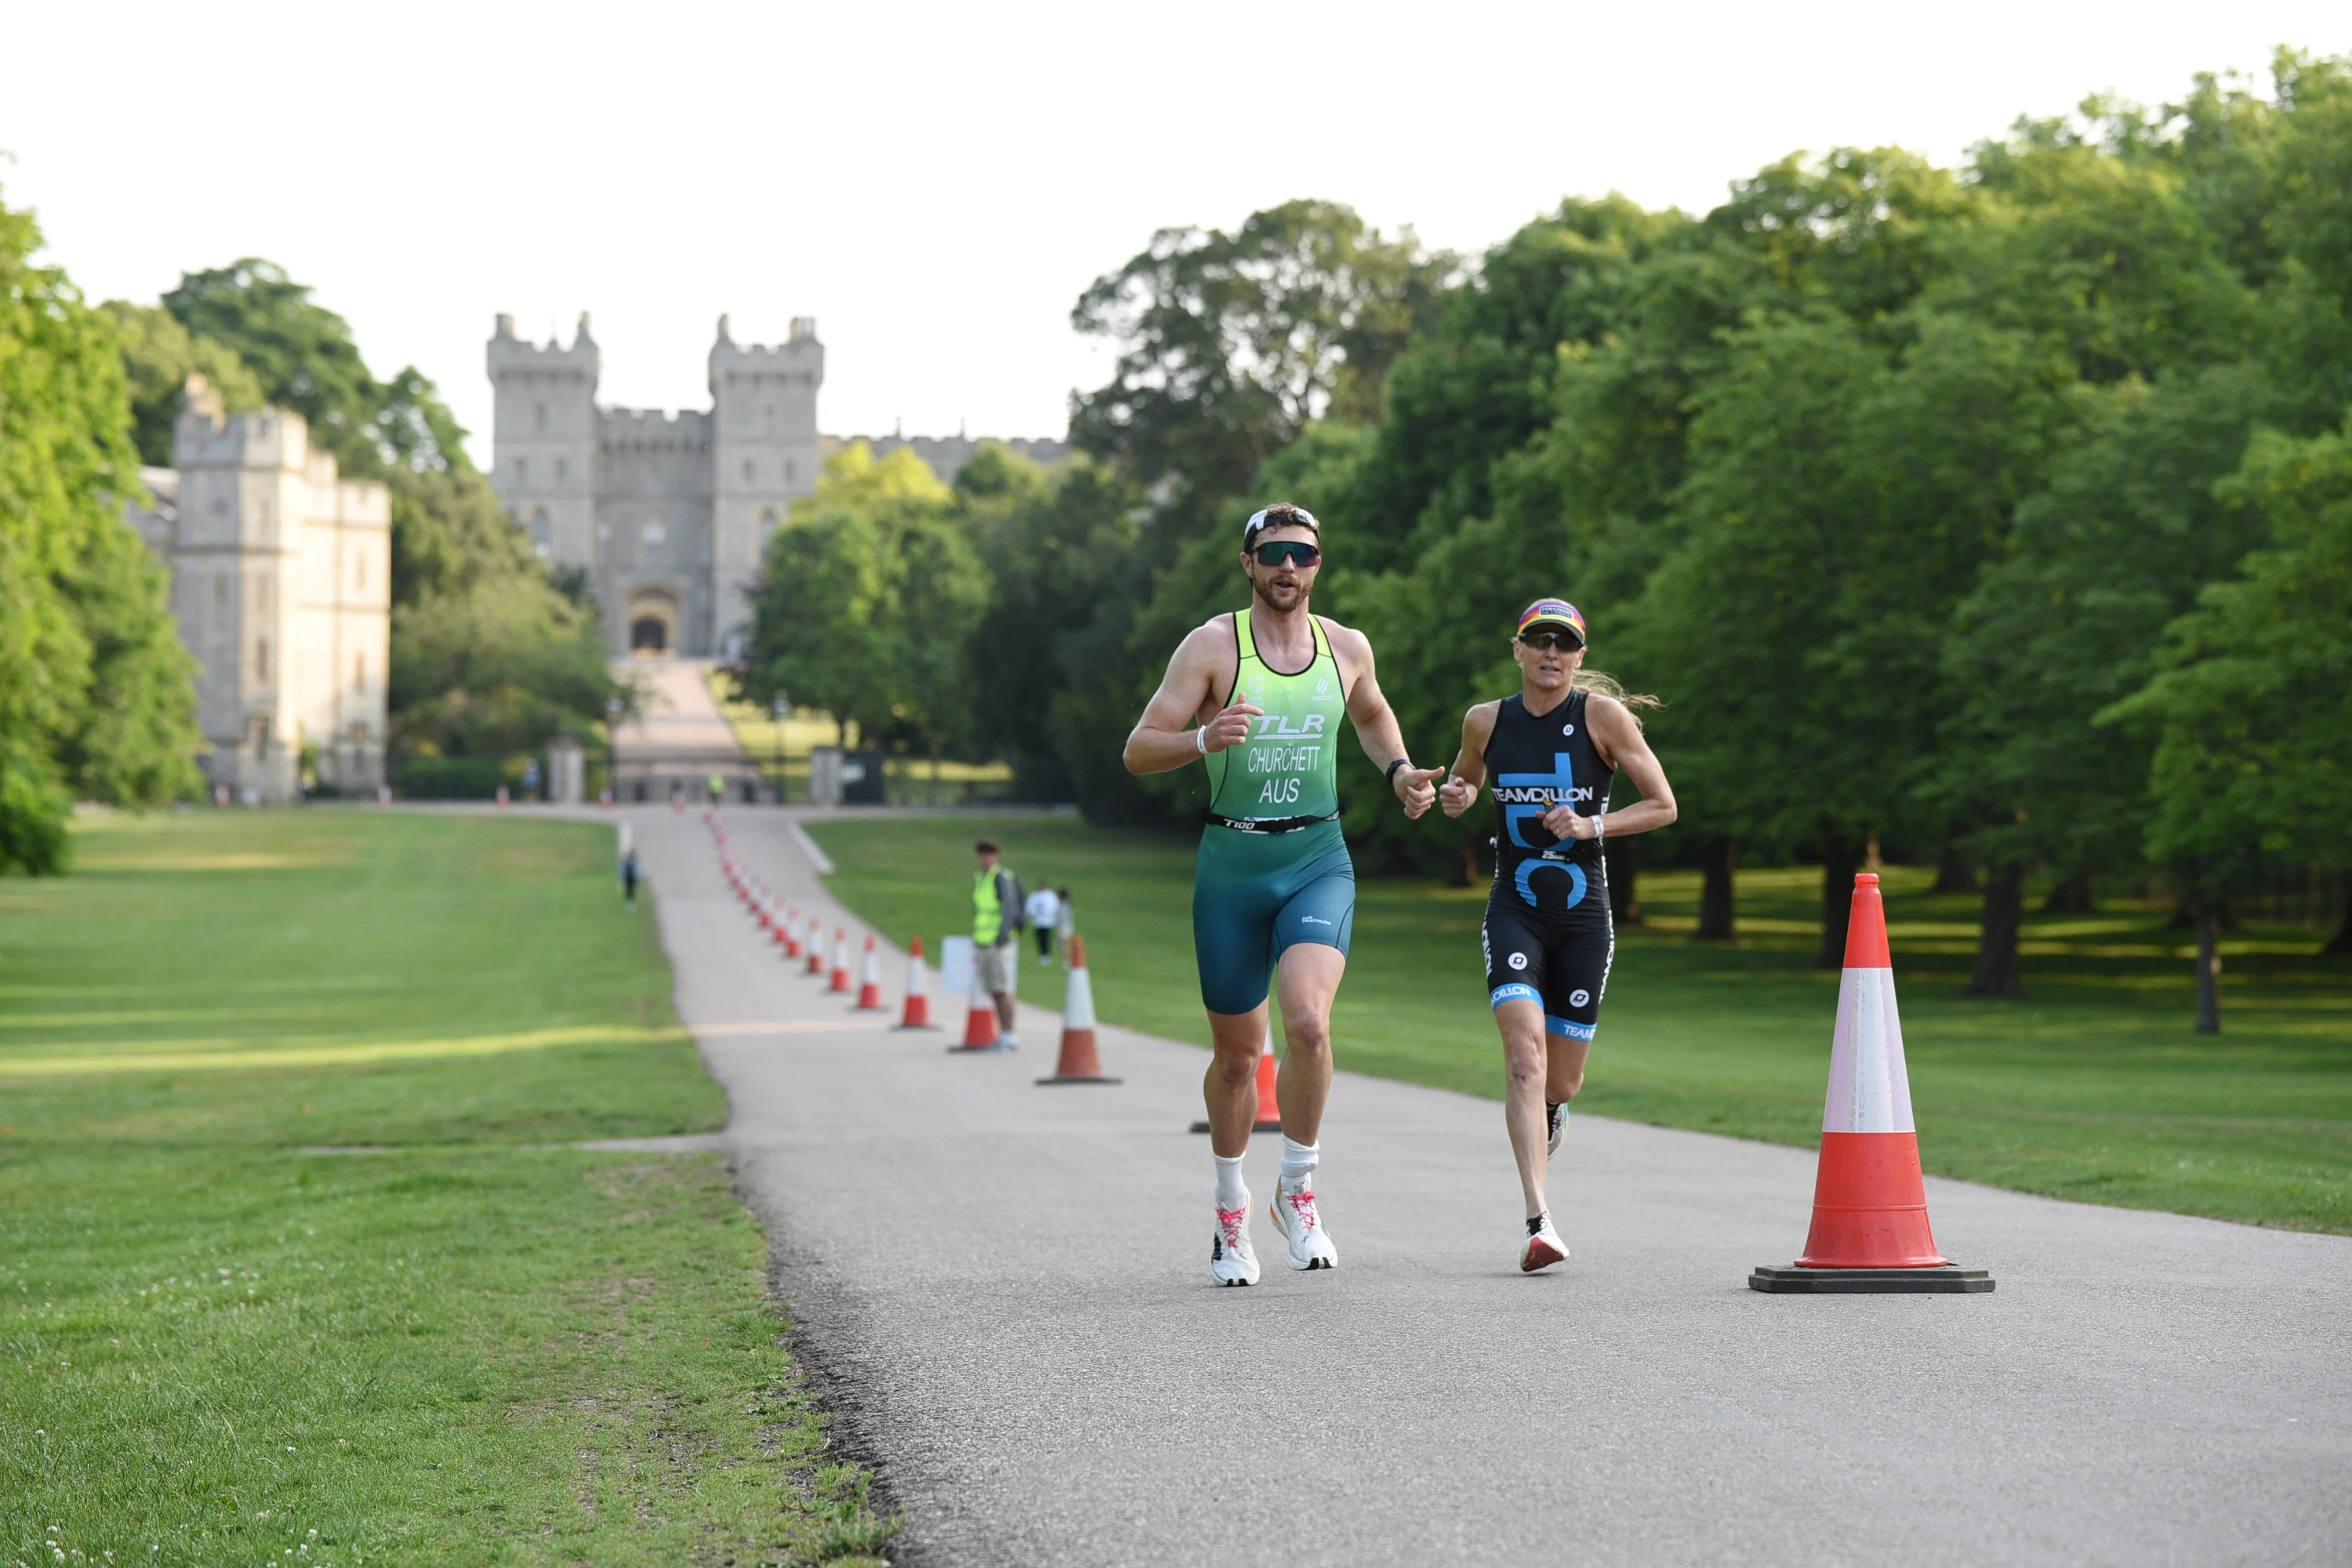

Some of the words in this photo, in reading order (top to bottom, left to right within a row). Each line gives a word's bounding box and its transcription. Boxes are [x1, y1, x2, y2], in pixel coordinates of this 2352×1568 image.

[1254, 714, 1325, 734] TLR
[1248, 746, 1320, 773] CHURCHETT
[1258, 778, 1301, 804] AUS
[1223, 818, 1256, 830] T100
